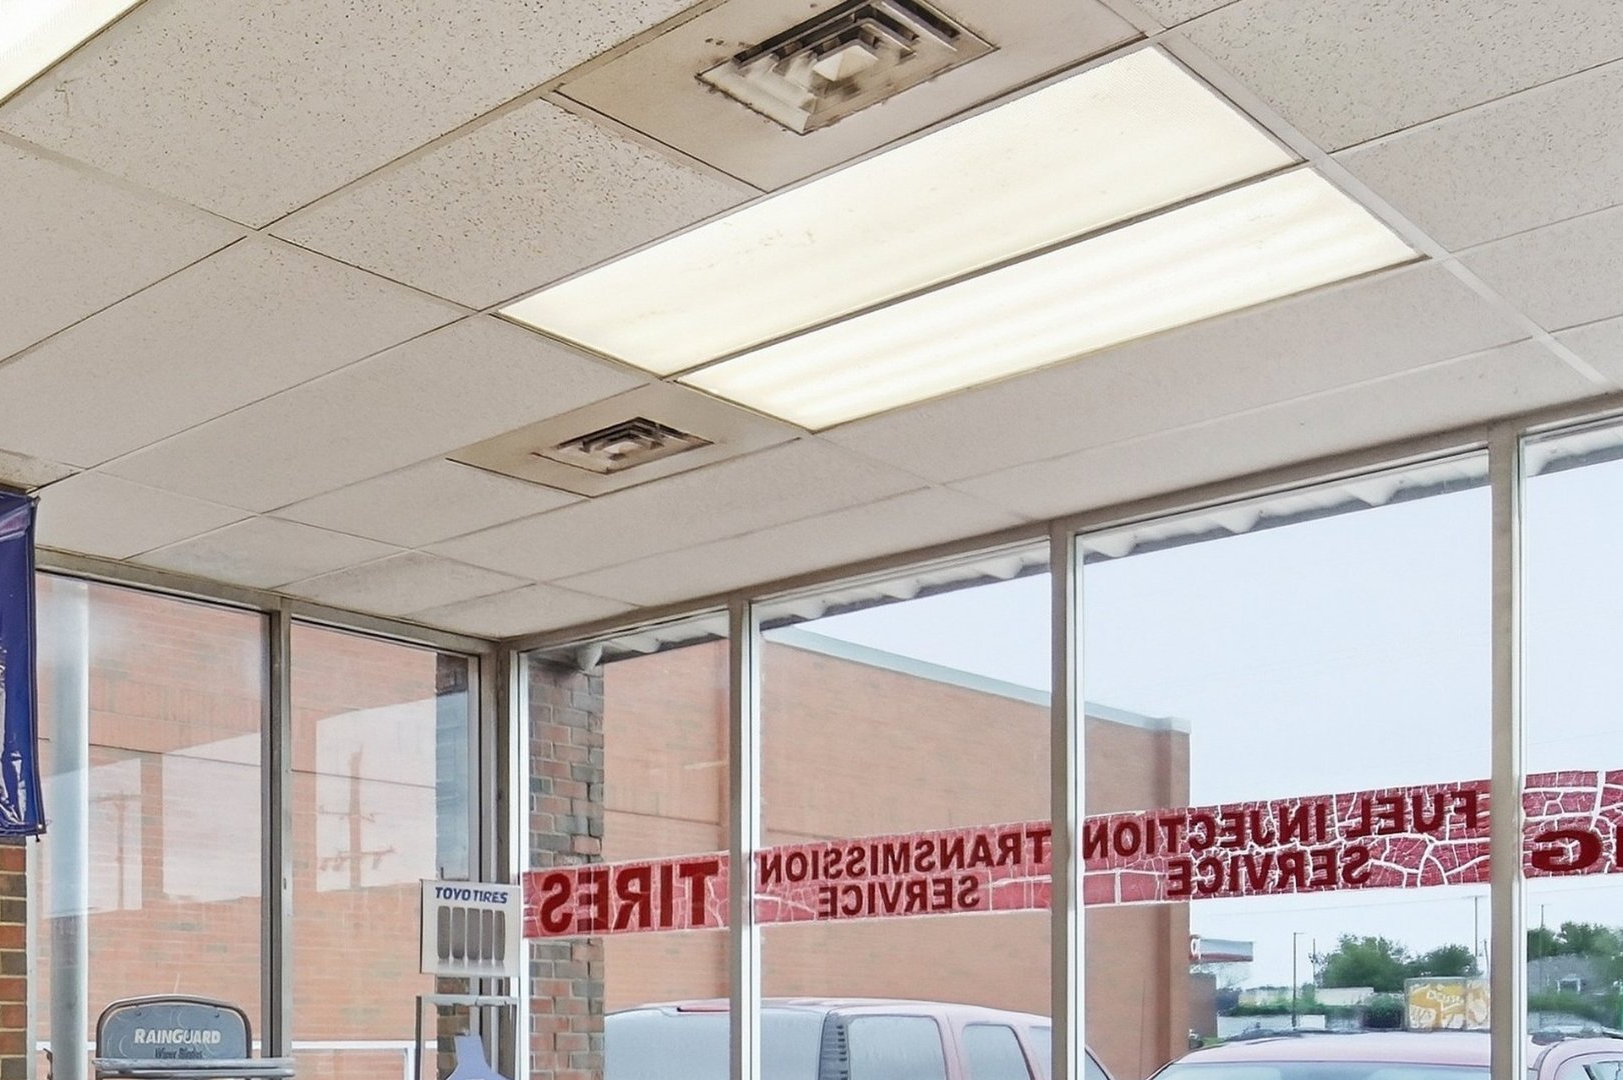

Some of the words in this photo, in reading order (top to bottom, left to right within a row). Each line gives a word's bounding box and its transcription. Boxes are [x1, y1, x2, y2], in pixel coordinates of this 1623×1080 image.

[435, 887, 471, 901] TOYO
[473, 890, 508, 904] TIRES
[134, 1028, 221, 1044] RAINGUARD
